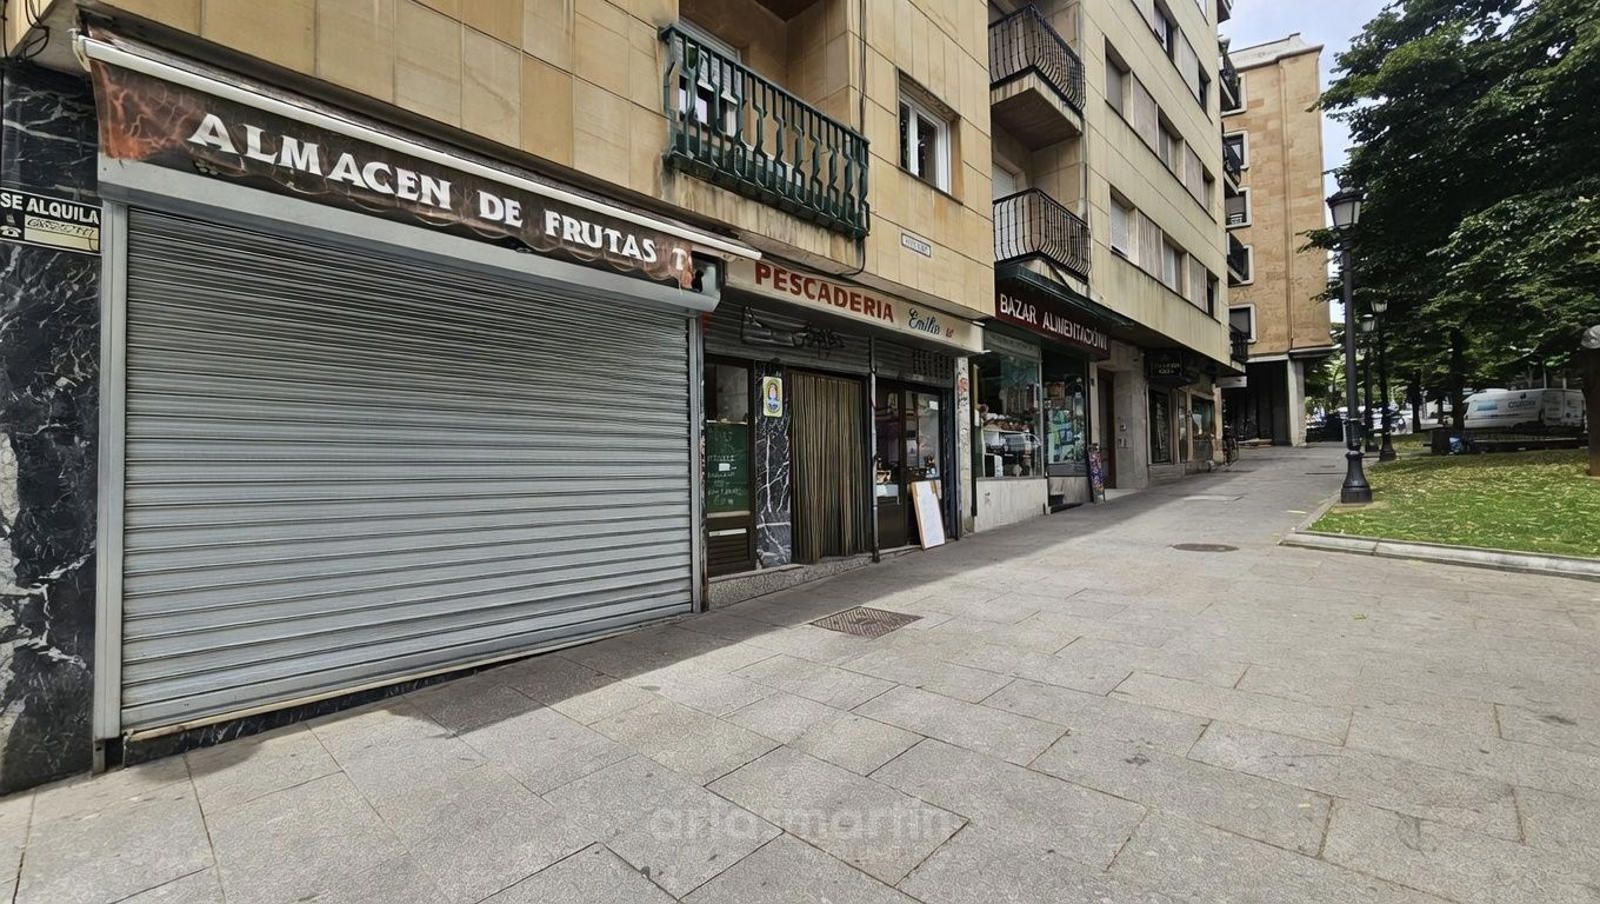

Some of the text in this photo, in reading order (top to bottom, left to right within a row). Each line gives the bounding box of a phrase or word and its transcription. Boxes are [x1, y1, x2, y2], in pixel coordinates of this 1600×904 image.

[0, 192, 100, 225] SE ALQUILA
[187, 113, 453, 211] ALMACEN
[478, 190, 524, 228] DE
[544, 209, 658, 264] FRUTAS
[754, 262, 895, 323] PESCADERIA
[999, 293, 1038, 325] BAZAR
